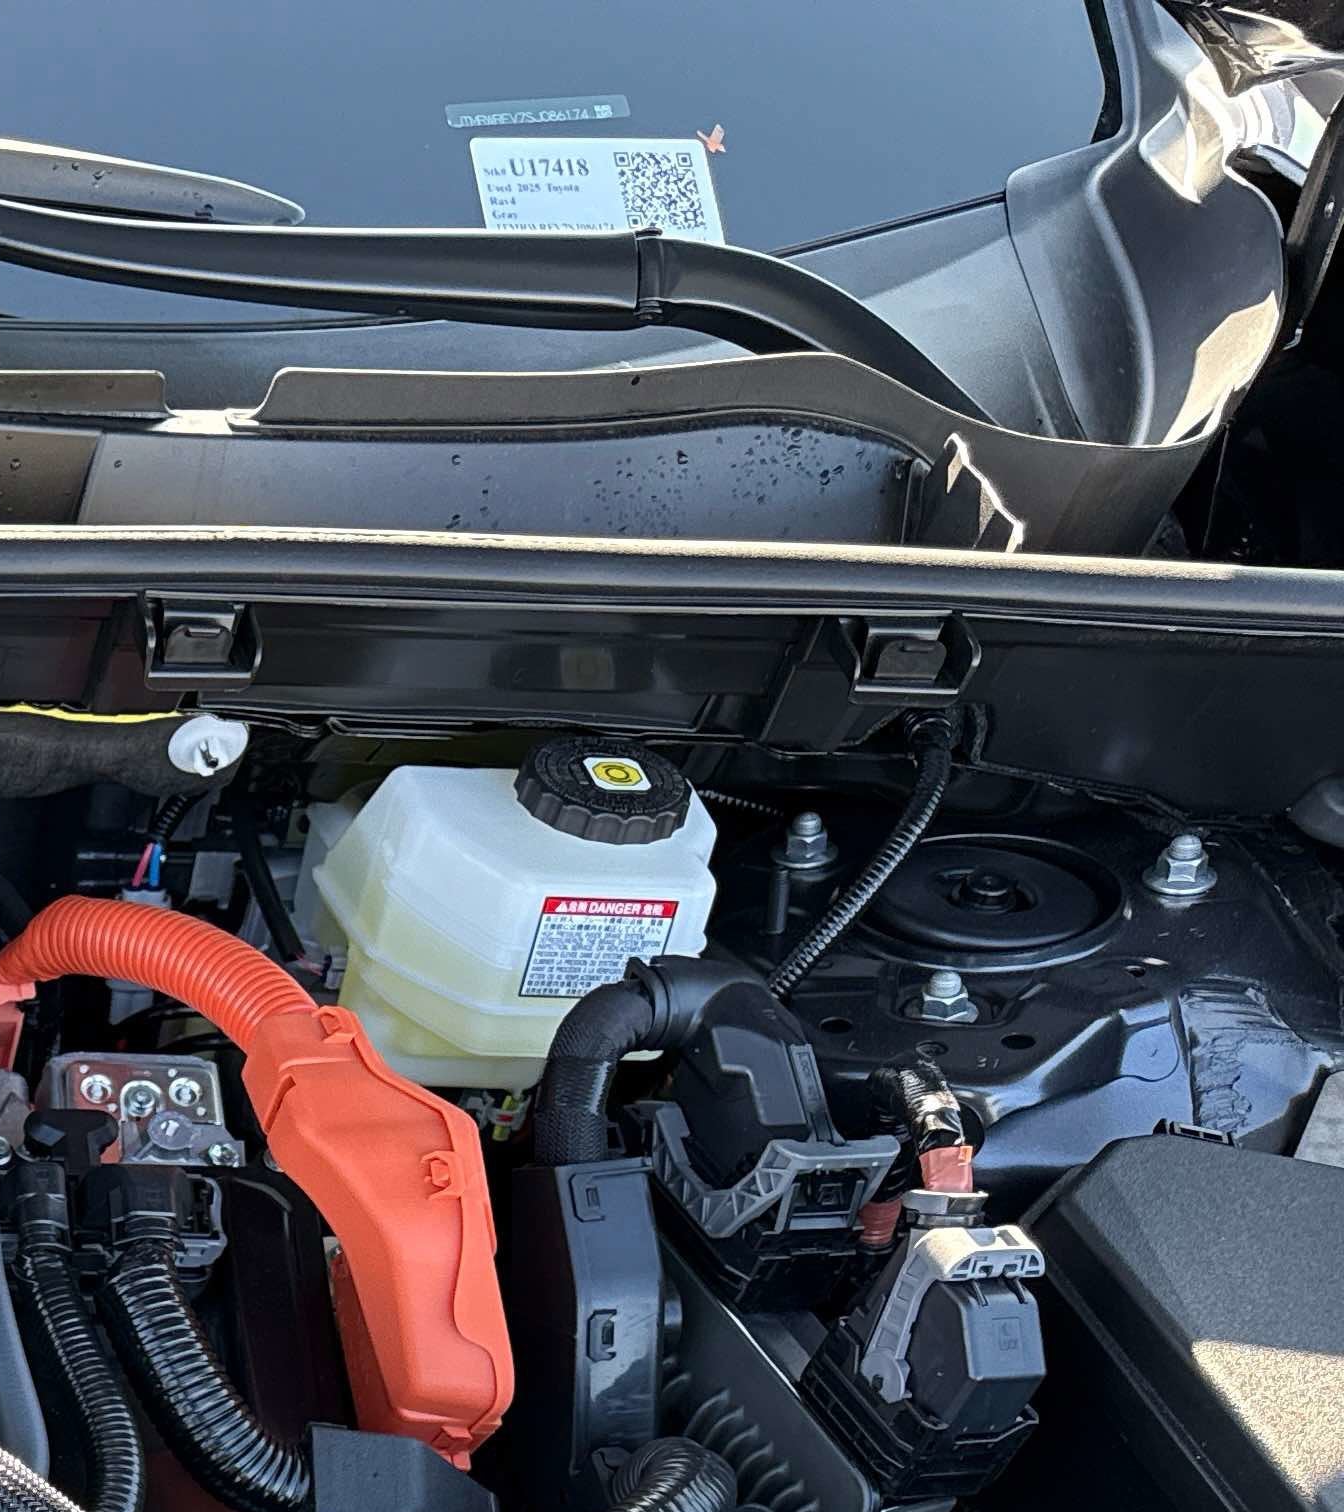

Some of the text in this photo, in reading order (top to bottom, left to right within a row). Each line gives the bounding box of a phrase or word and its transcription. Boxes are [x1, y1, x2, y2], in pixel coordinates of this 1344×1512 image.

[508, 158, 590, 177] U17418
[487, 183, 581, 194] Used 2025 Toyota
[588, 902, 641, 914] DANGER
